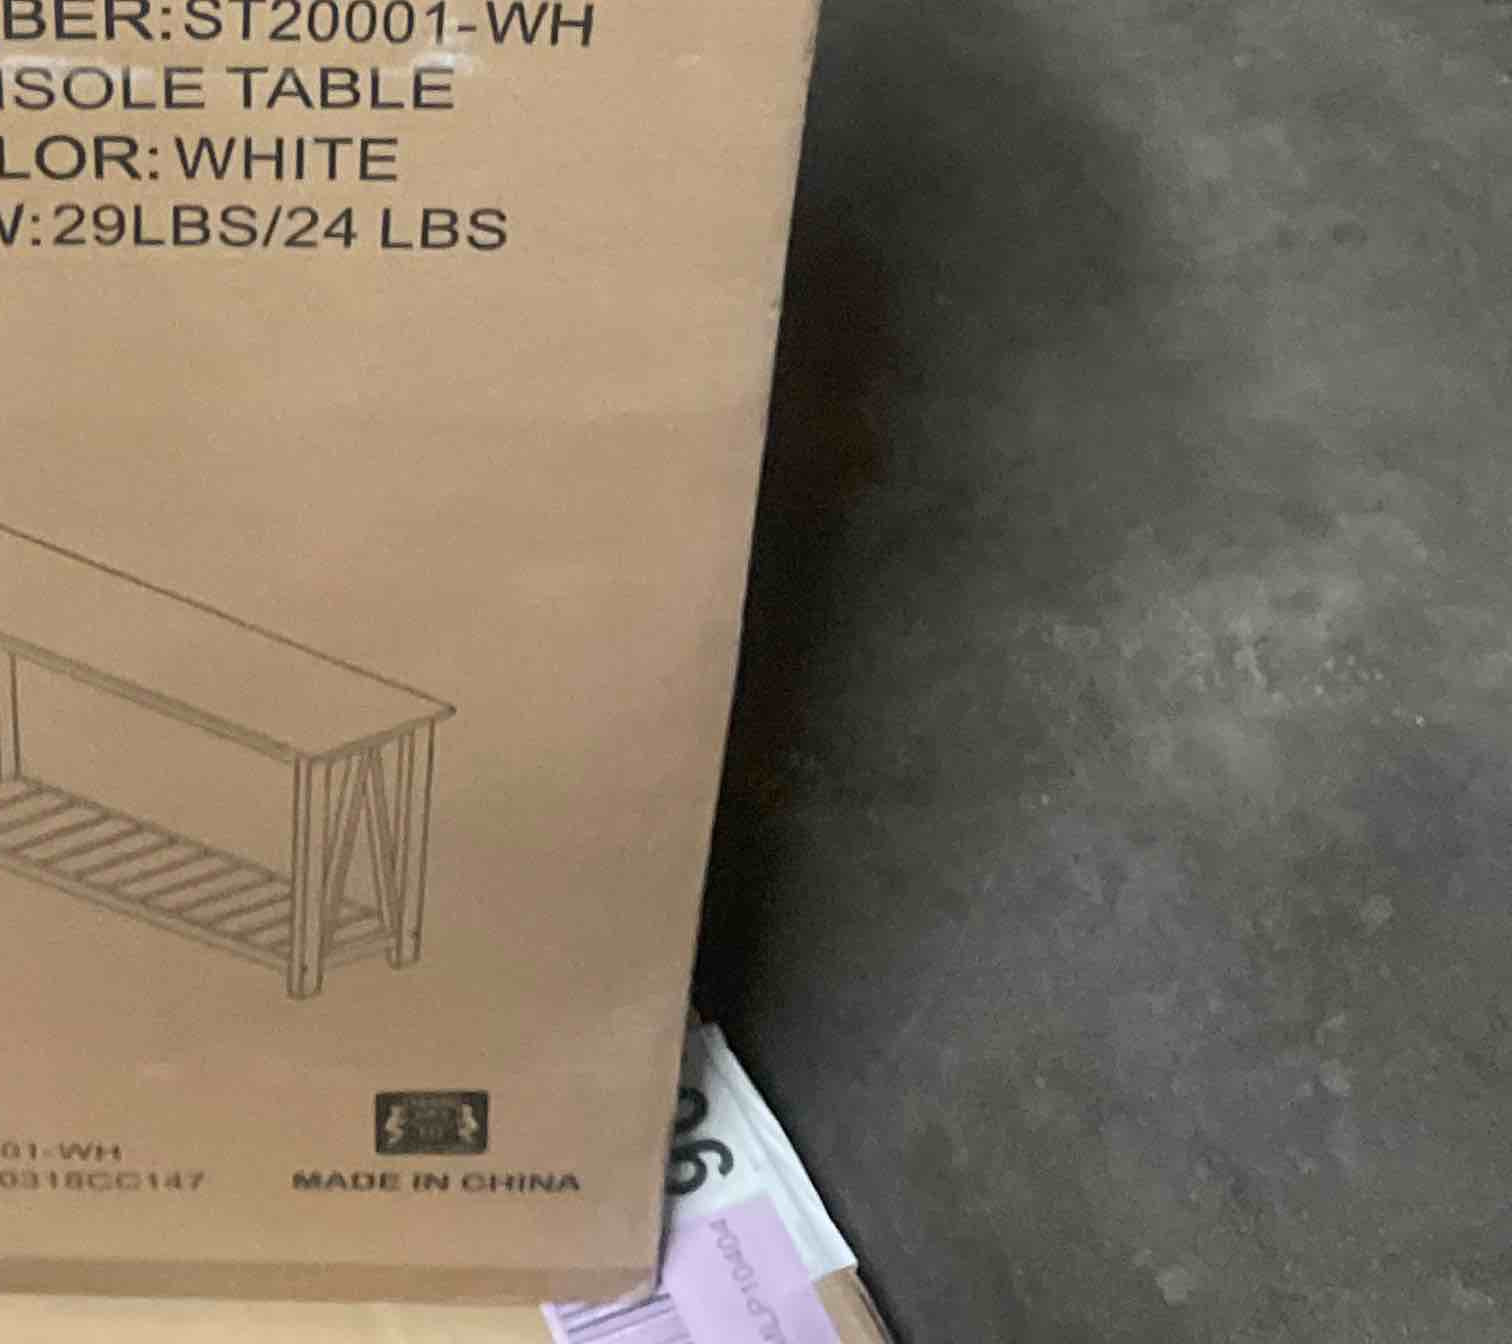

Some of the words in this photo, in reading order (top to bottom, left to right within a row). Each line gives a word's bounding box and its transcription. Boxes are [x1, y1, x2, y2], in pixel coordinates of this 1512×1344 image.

[225, 65, 456, 110] TABLE
[381, 206, 509, 252] LBS
[291, 1168, 401, 1192] MADE
[411, 1169, 451, 1192] IN
[460, 1169, 582, 1194] CHINA
